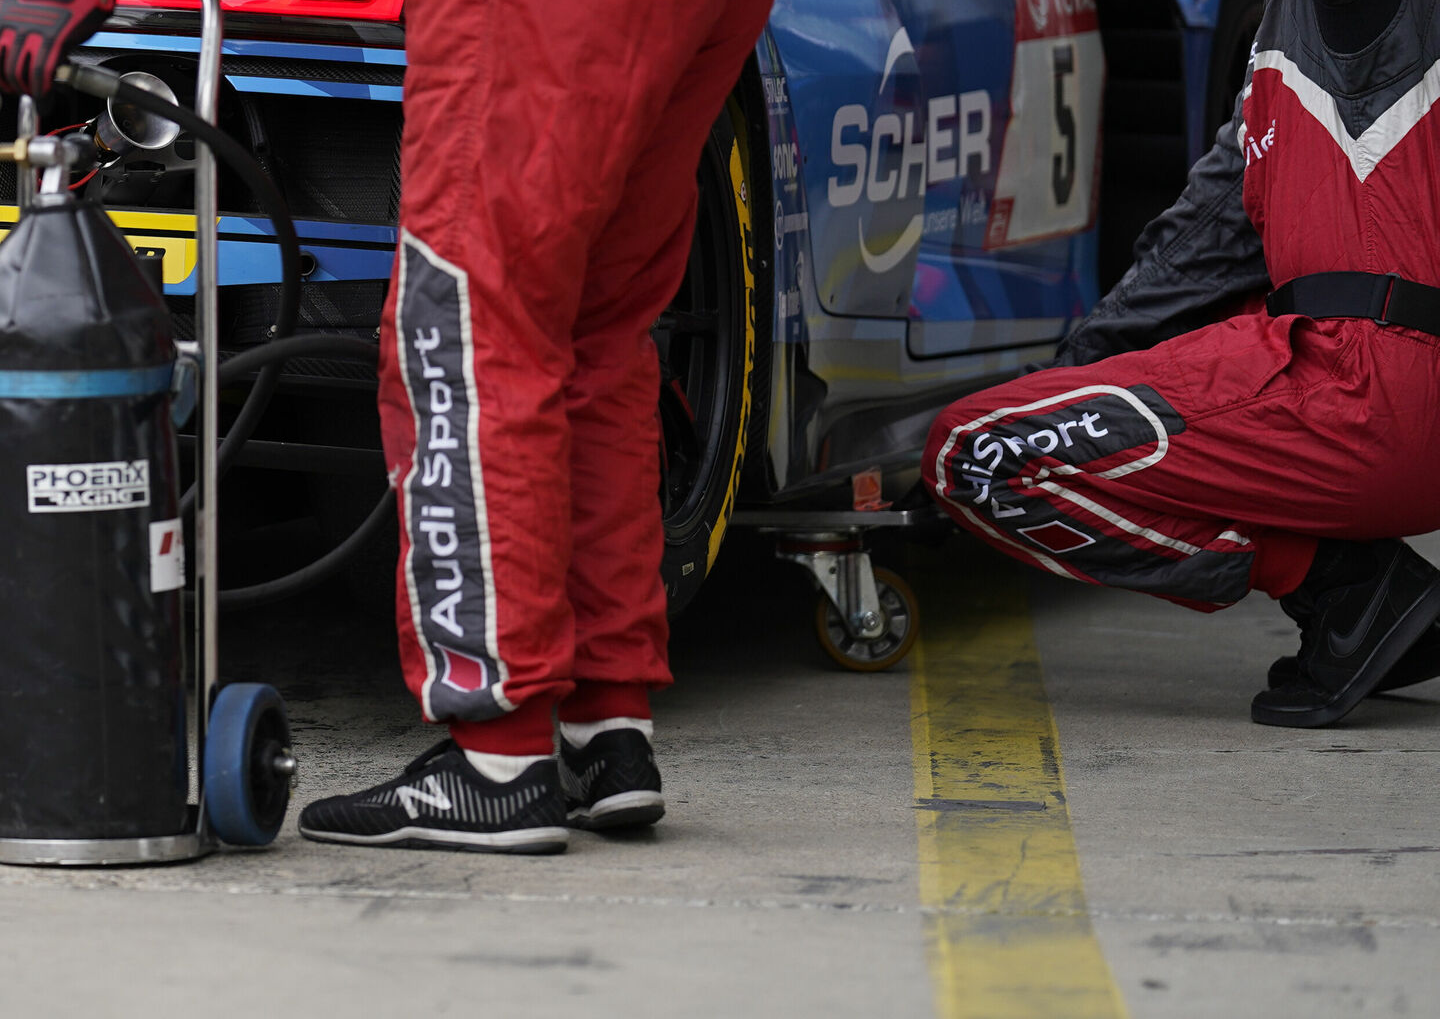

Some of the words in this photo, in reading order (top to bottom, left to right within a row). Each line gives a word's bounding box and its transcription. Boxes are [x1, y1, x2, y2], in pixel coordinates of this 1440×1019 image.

[1052, 44, 1077, 208] 5
[413, 326, 459, 488] Sport
[419, 504, 464, 638] Audi
